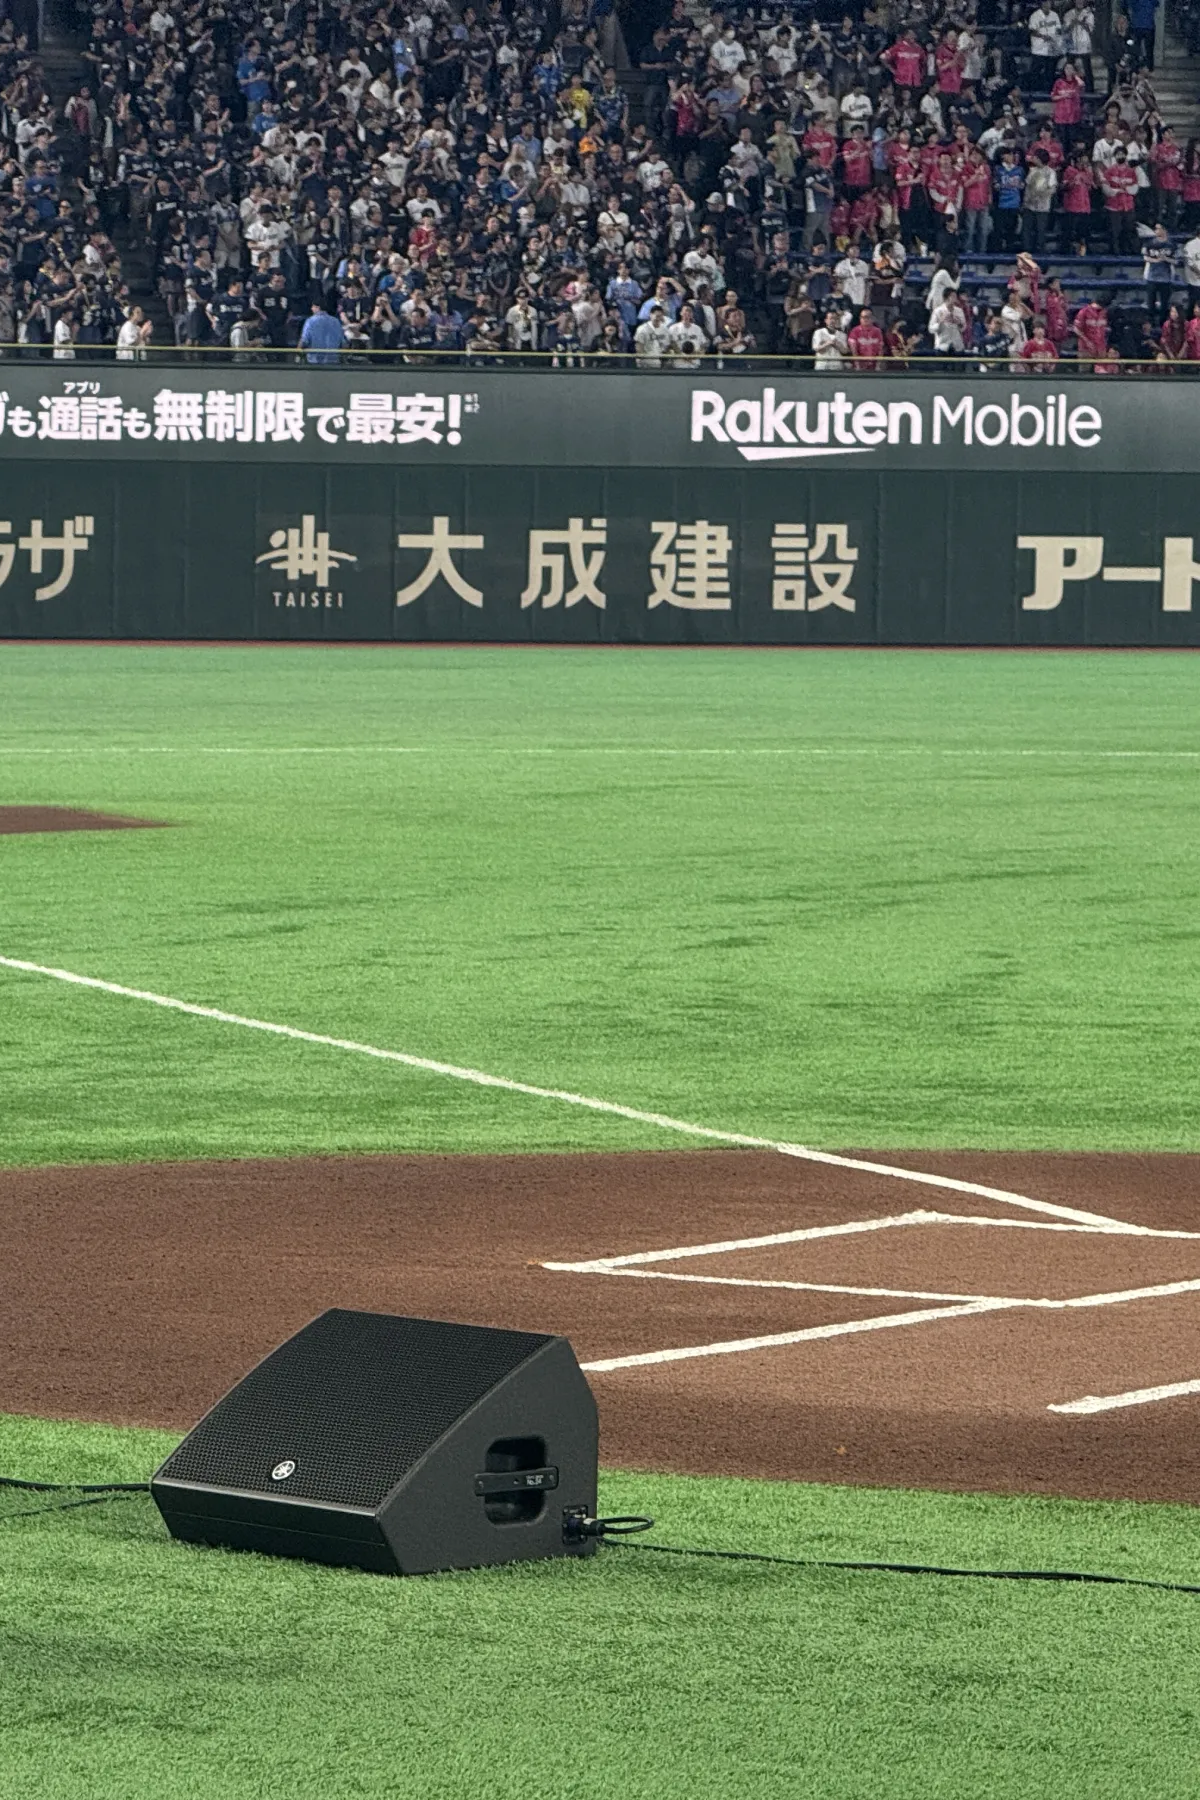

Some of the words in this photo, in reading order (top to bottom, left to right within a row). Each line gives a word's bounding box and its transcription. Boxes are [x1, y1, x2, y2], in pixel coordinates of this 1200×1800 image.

[691, 388, 923, 446] Rakuten
[932, 393, 1103, 448] Mobile
[396, 516, 859, 612] 大成建設
[272, 592, 343, 608] TAISEI
